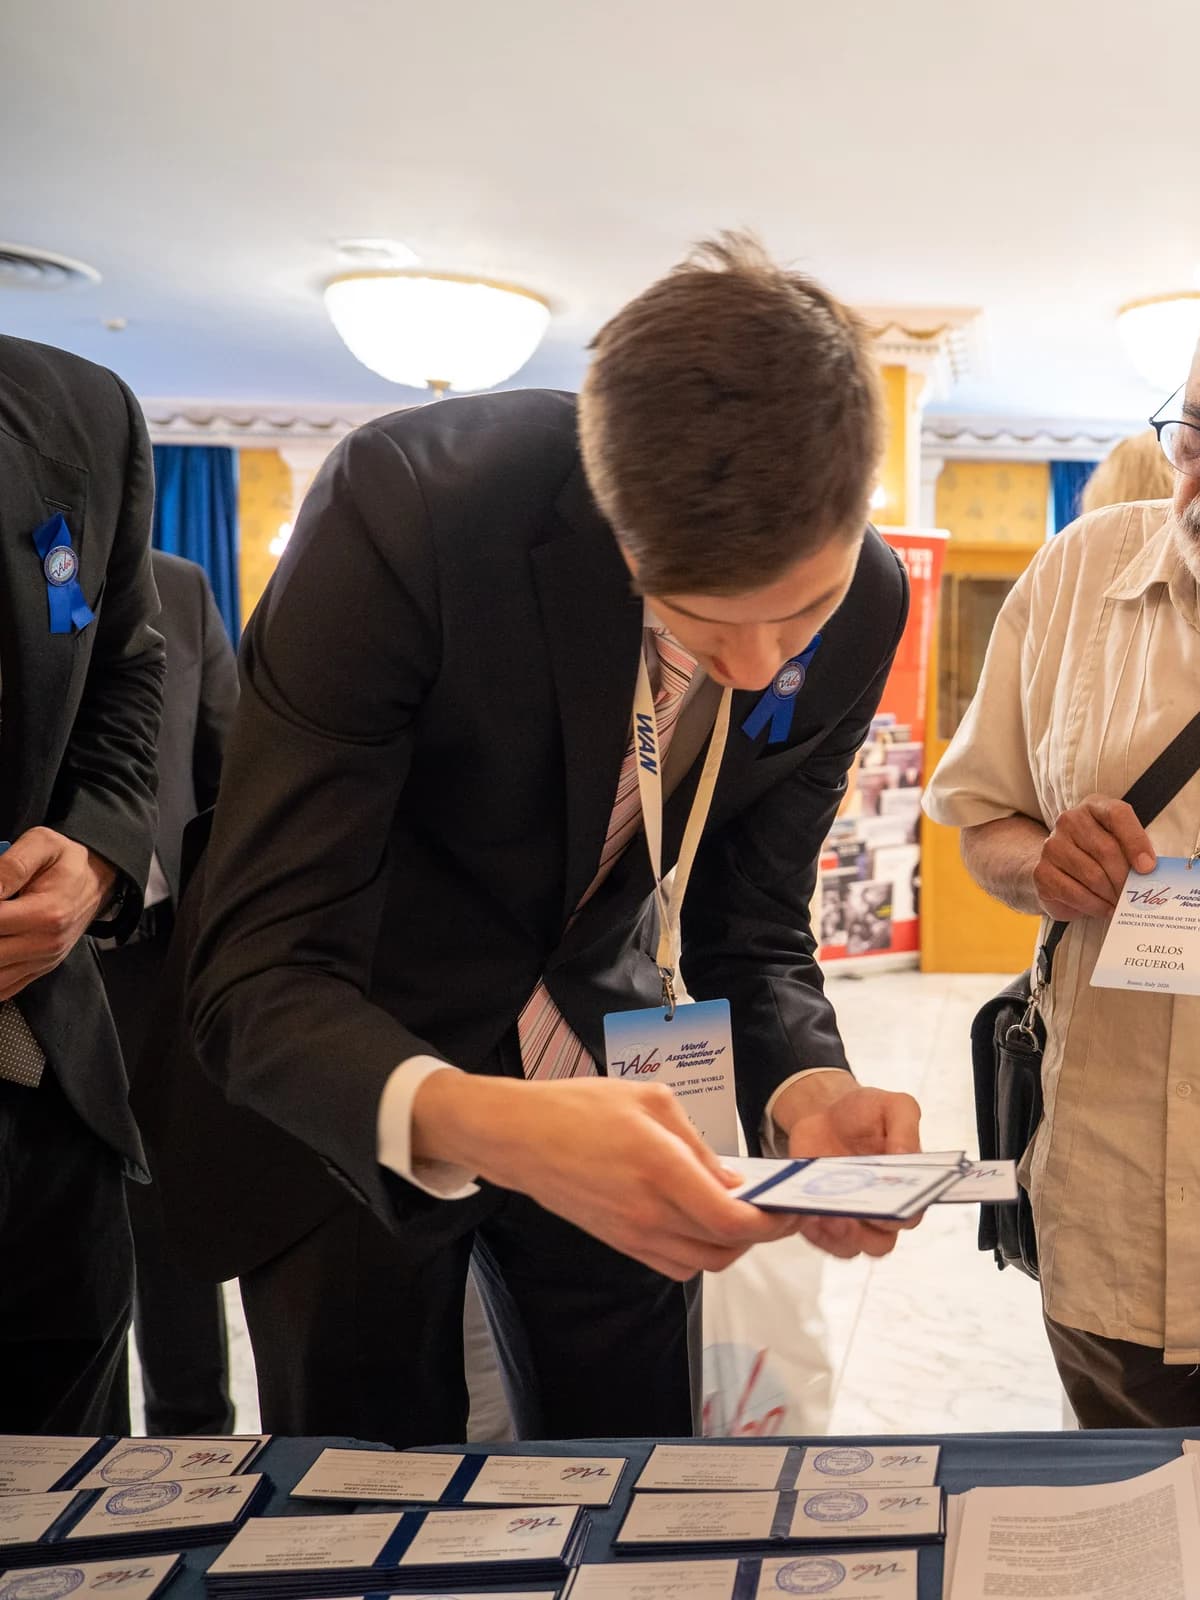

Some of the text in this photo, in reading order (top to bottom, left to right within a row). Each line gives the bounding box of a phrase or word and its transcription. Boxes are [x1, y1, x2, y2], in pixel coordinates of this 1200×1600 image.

[635, 712, 658, 776] WAN
[1136, 943, 1184, 955] CARLOS
[1124, 957, 1185, 971] FIGUEROA
[681, 1040, 709, 1051] World
[665, 1046, 726, 1062] Association of
[676, 1058, 717, 1068] Noonomy
[701, 1074, 724, 1082] WORLD
[675, 1087, 704, 1096] OONOMY
